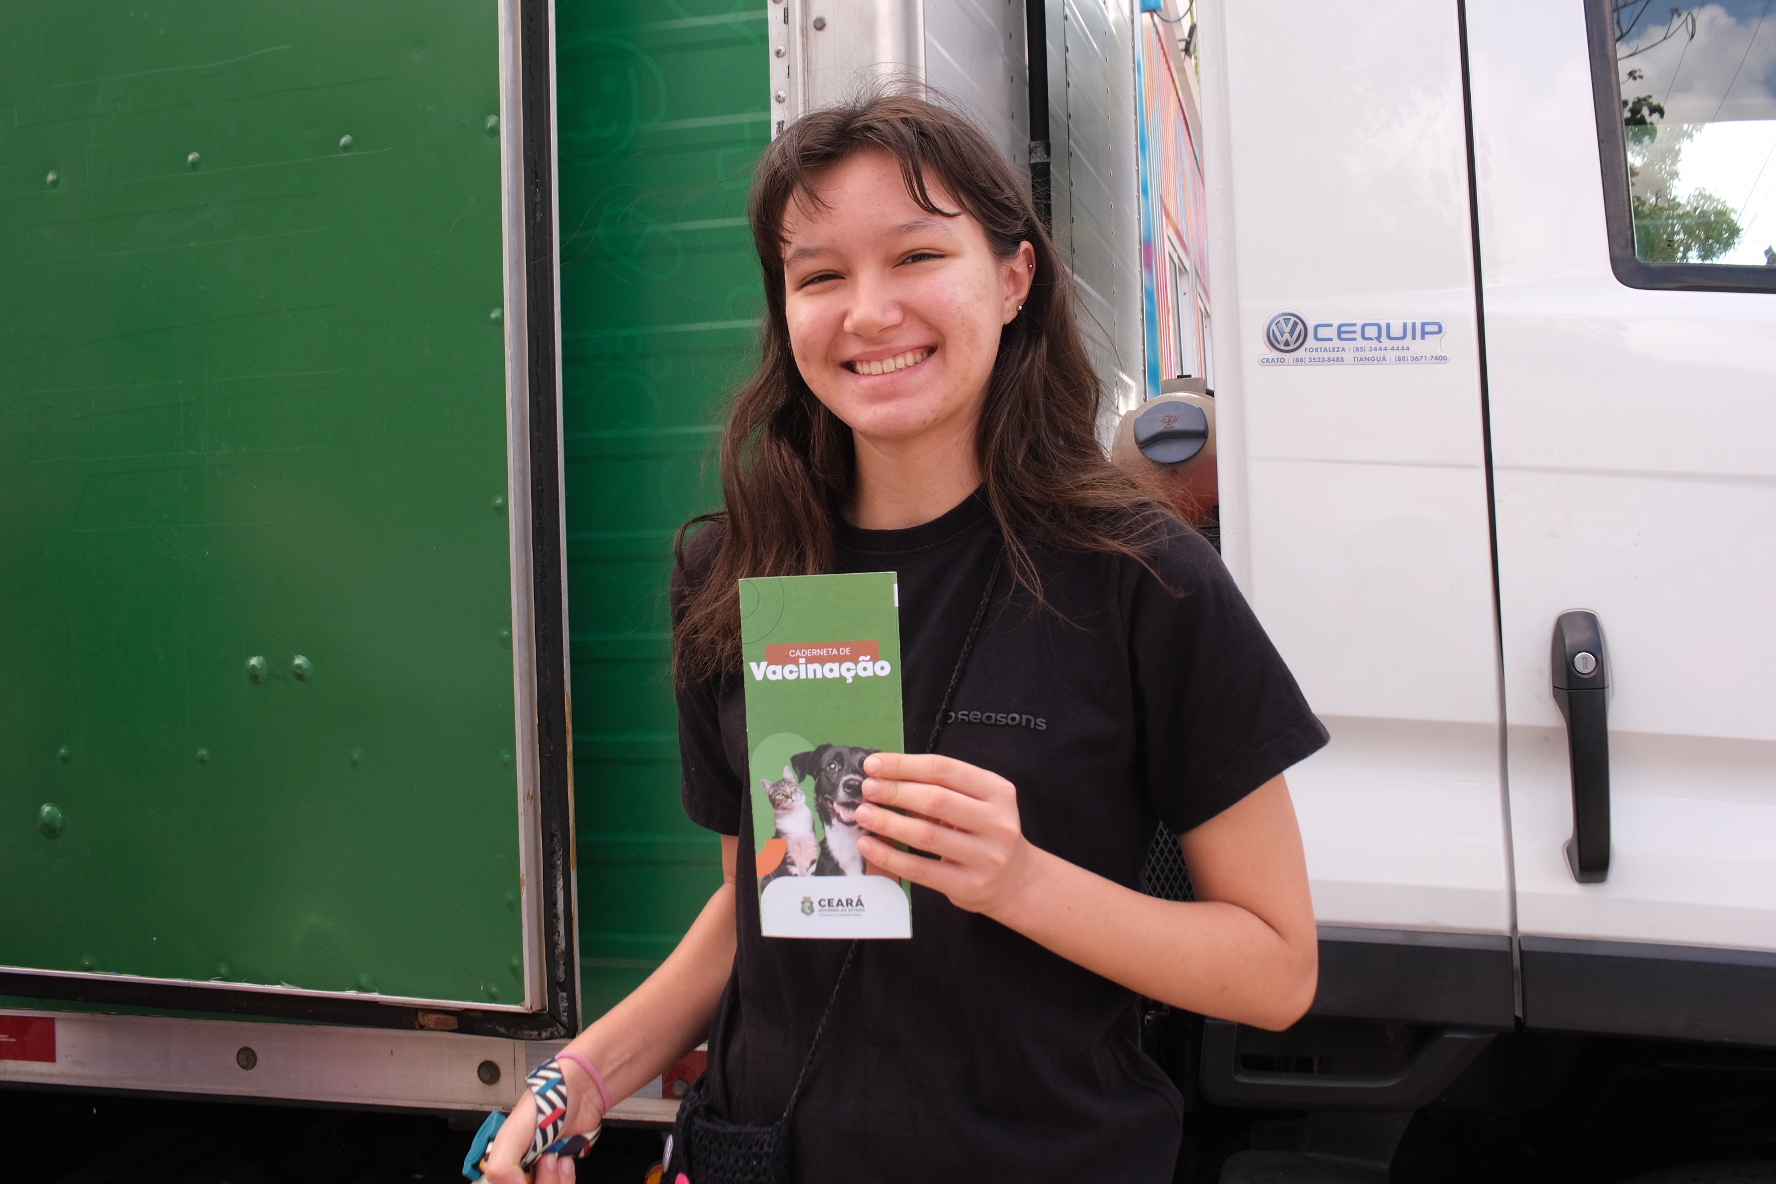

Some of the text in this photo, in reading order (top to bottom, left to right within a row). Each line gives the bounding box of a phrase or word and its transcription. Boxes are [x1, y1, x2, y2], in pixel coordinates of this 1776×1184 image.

[1270, 315, 1304, 349] VW
[1313, 321, 1443, 343] CEQUIP
[788, 647, 851, 657] CADERNETA DE
[749, 655, 891, 683] Vacinação
[818, 894, 864, 908] CEARÁ
